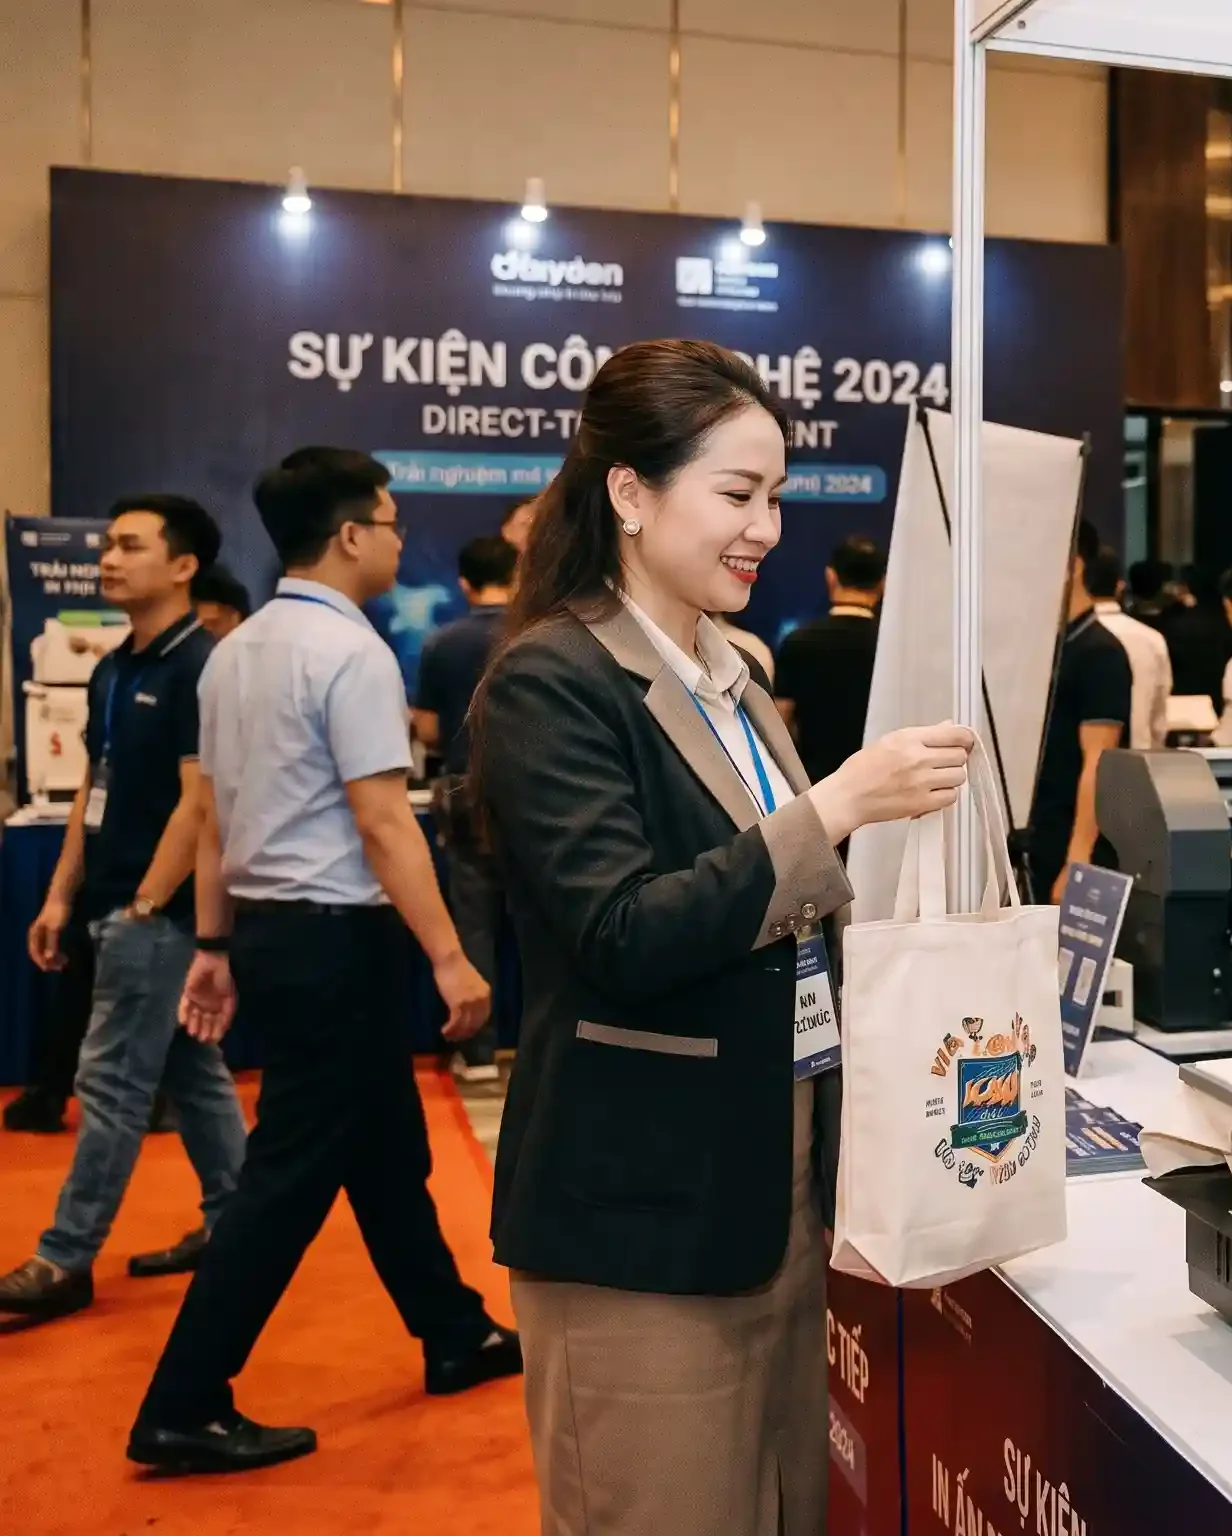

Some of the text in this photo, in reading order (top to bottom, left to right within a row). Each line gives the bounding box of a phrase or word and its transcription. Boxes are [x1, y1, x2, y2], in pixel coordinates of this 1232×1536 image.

[288, 328, 949, 410] SỰ KIỆN CÔ HỆ 2024
[422, 404, 839, 449] DIRECT-T NT
[837, 1324, 869, 1403] TIẾP
[933, 1453, 949, 1529] IN
[1003, 1437, 1031, 1530] SỰ
